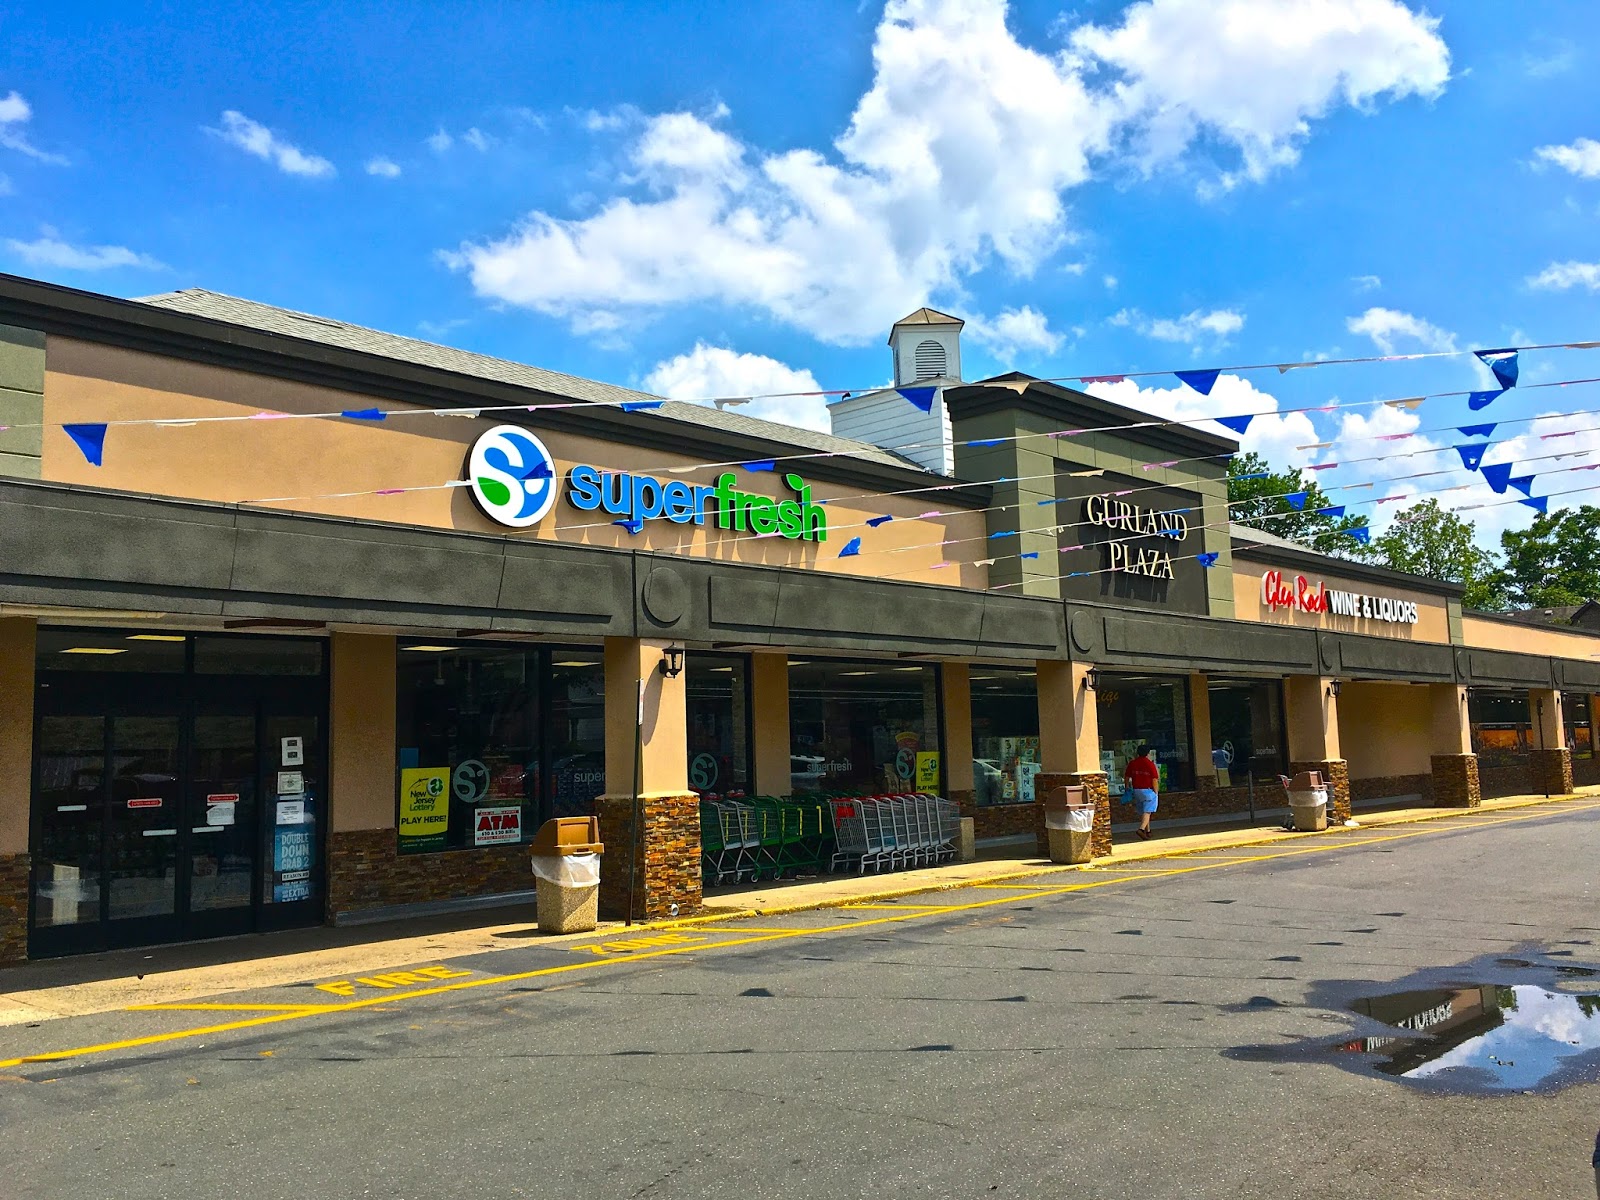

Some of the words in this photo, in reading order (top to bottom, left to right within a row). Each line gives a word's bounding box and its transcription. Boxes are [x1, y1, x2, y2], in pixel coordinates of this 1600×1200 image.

[566, 464, 828, 543] superfresh
[1087, 495, 1188, 541] GURLAND
[1109, 542, 1175, 580] PLAZA
[1262, 570, 1297, 613] Glen
[1295, 575, 1328, 614] Rock
[1329, 590, 1362, 617] WINE
[1362, 594, 1372, 619] &
[1372, 597, 1419, 624] LIQUORS
[806, 757, 853, 773] superfresh
[410, 790, 427, 798] New
[413, 797, 436, 805] Jersey
[409, 803, 436, 812] Lottery
[400, 816, 423, 825] PLAY
[423, 814, 447, 824] HERE!
[477, 814, 519, 831] ATM
[281, 833, 310, 846] DOUBLE
[281, 843, 310, 858] DOWN
[281, 857, 302, 871] GRAB
[303, 856, 310, 867] 2
[288, 887, 310, 898] EXTRA
[570, 934, 708, 955] ZONE
[314, 965, 473, 996] FIRE
